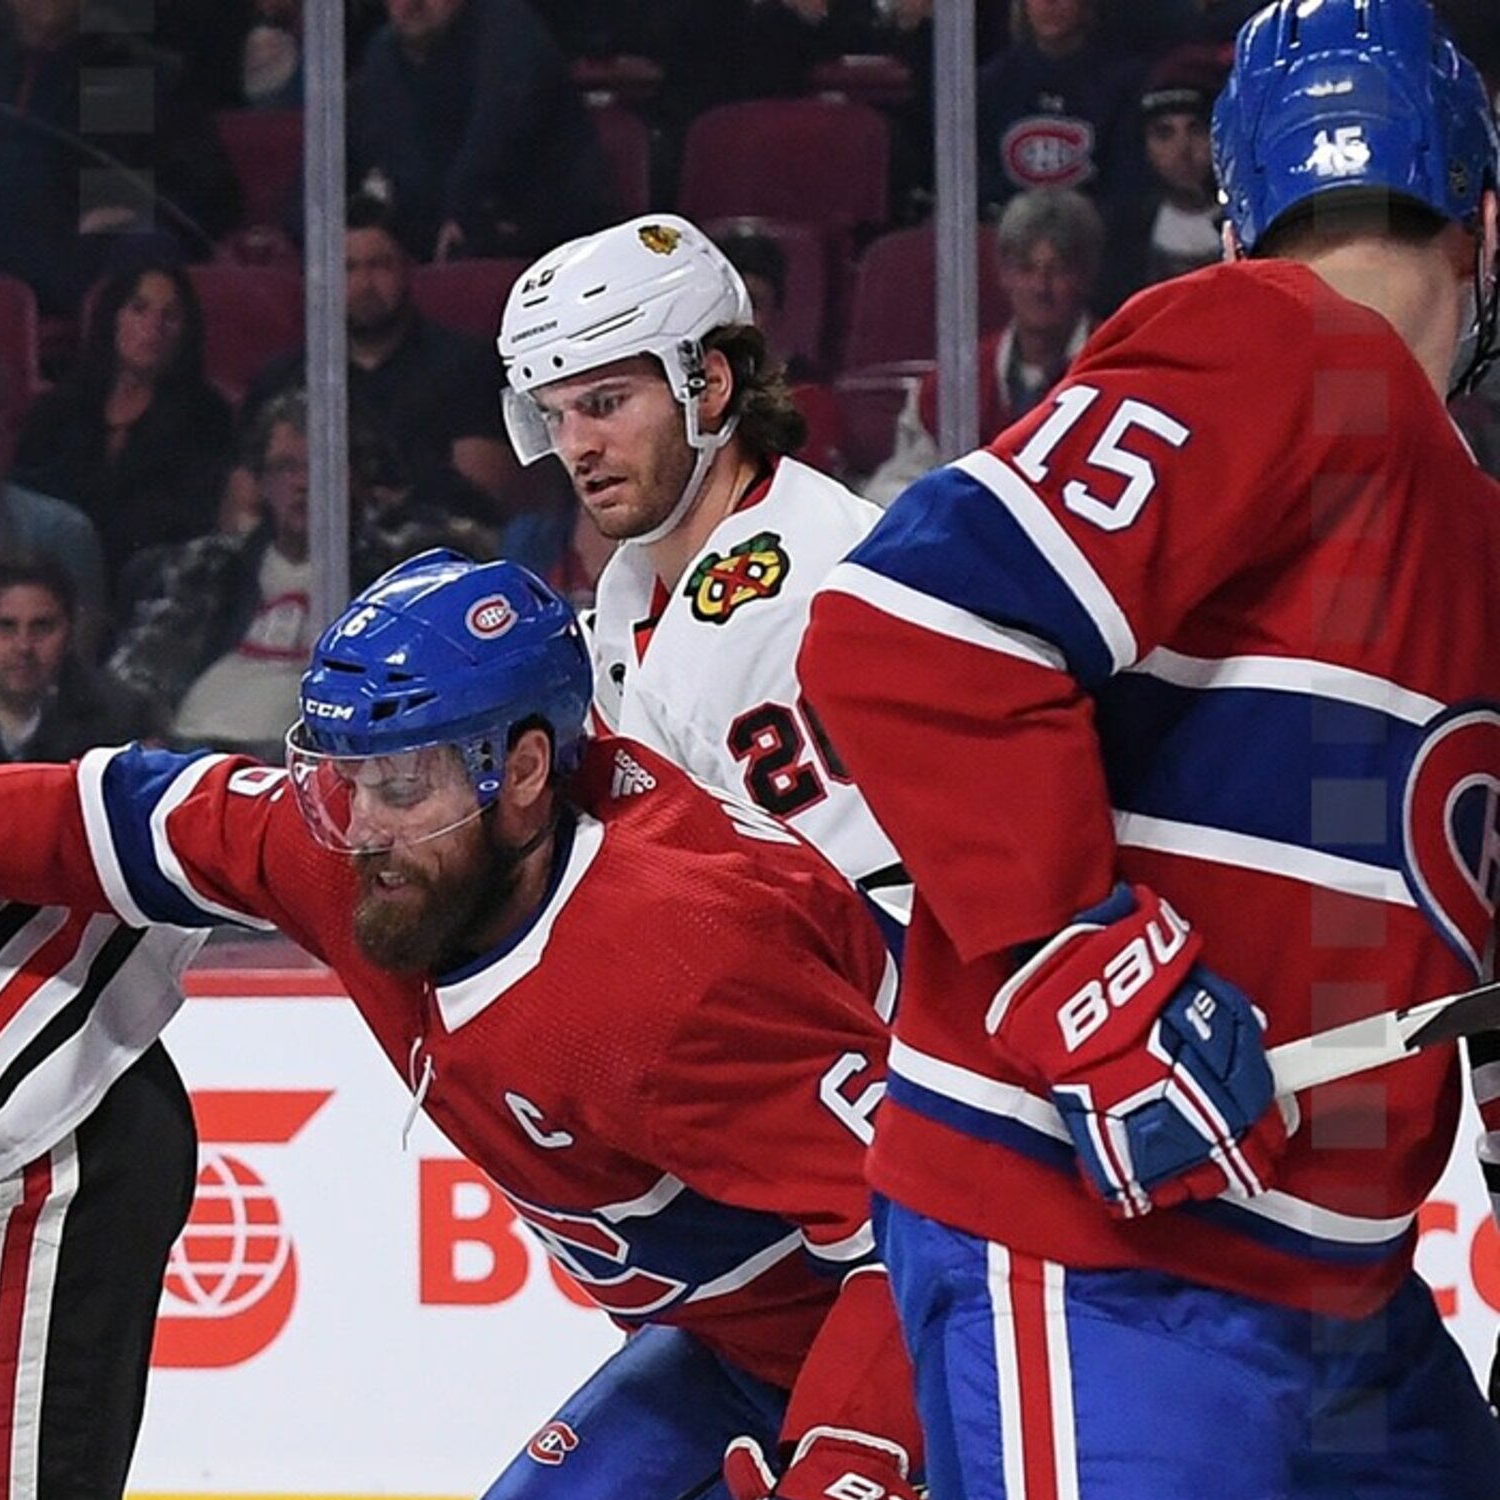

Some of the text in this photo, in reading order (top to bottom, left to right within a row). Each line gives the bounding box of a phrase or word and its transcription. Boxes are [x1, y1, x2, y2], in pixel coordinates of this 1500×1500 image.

[1011, 384, 1191, 533] 15
[305, 700, 354, 720] CCM
[1057, 899, 1194, 1052] BAU
[505, 1092, 573, 1148] C
